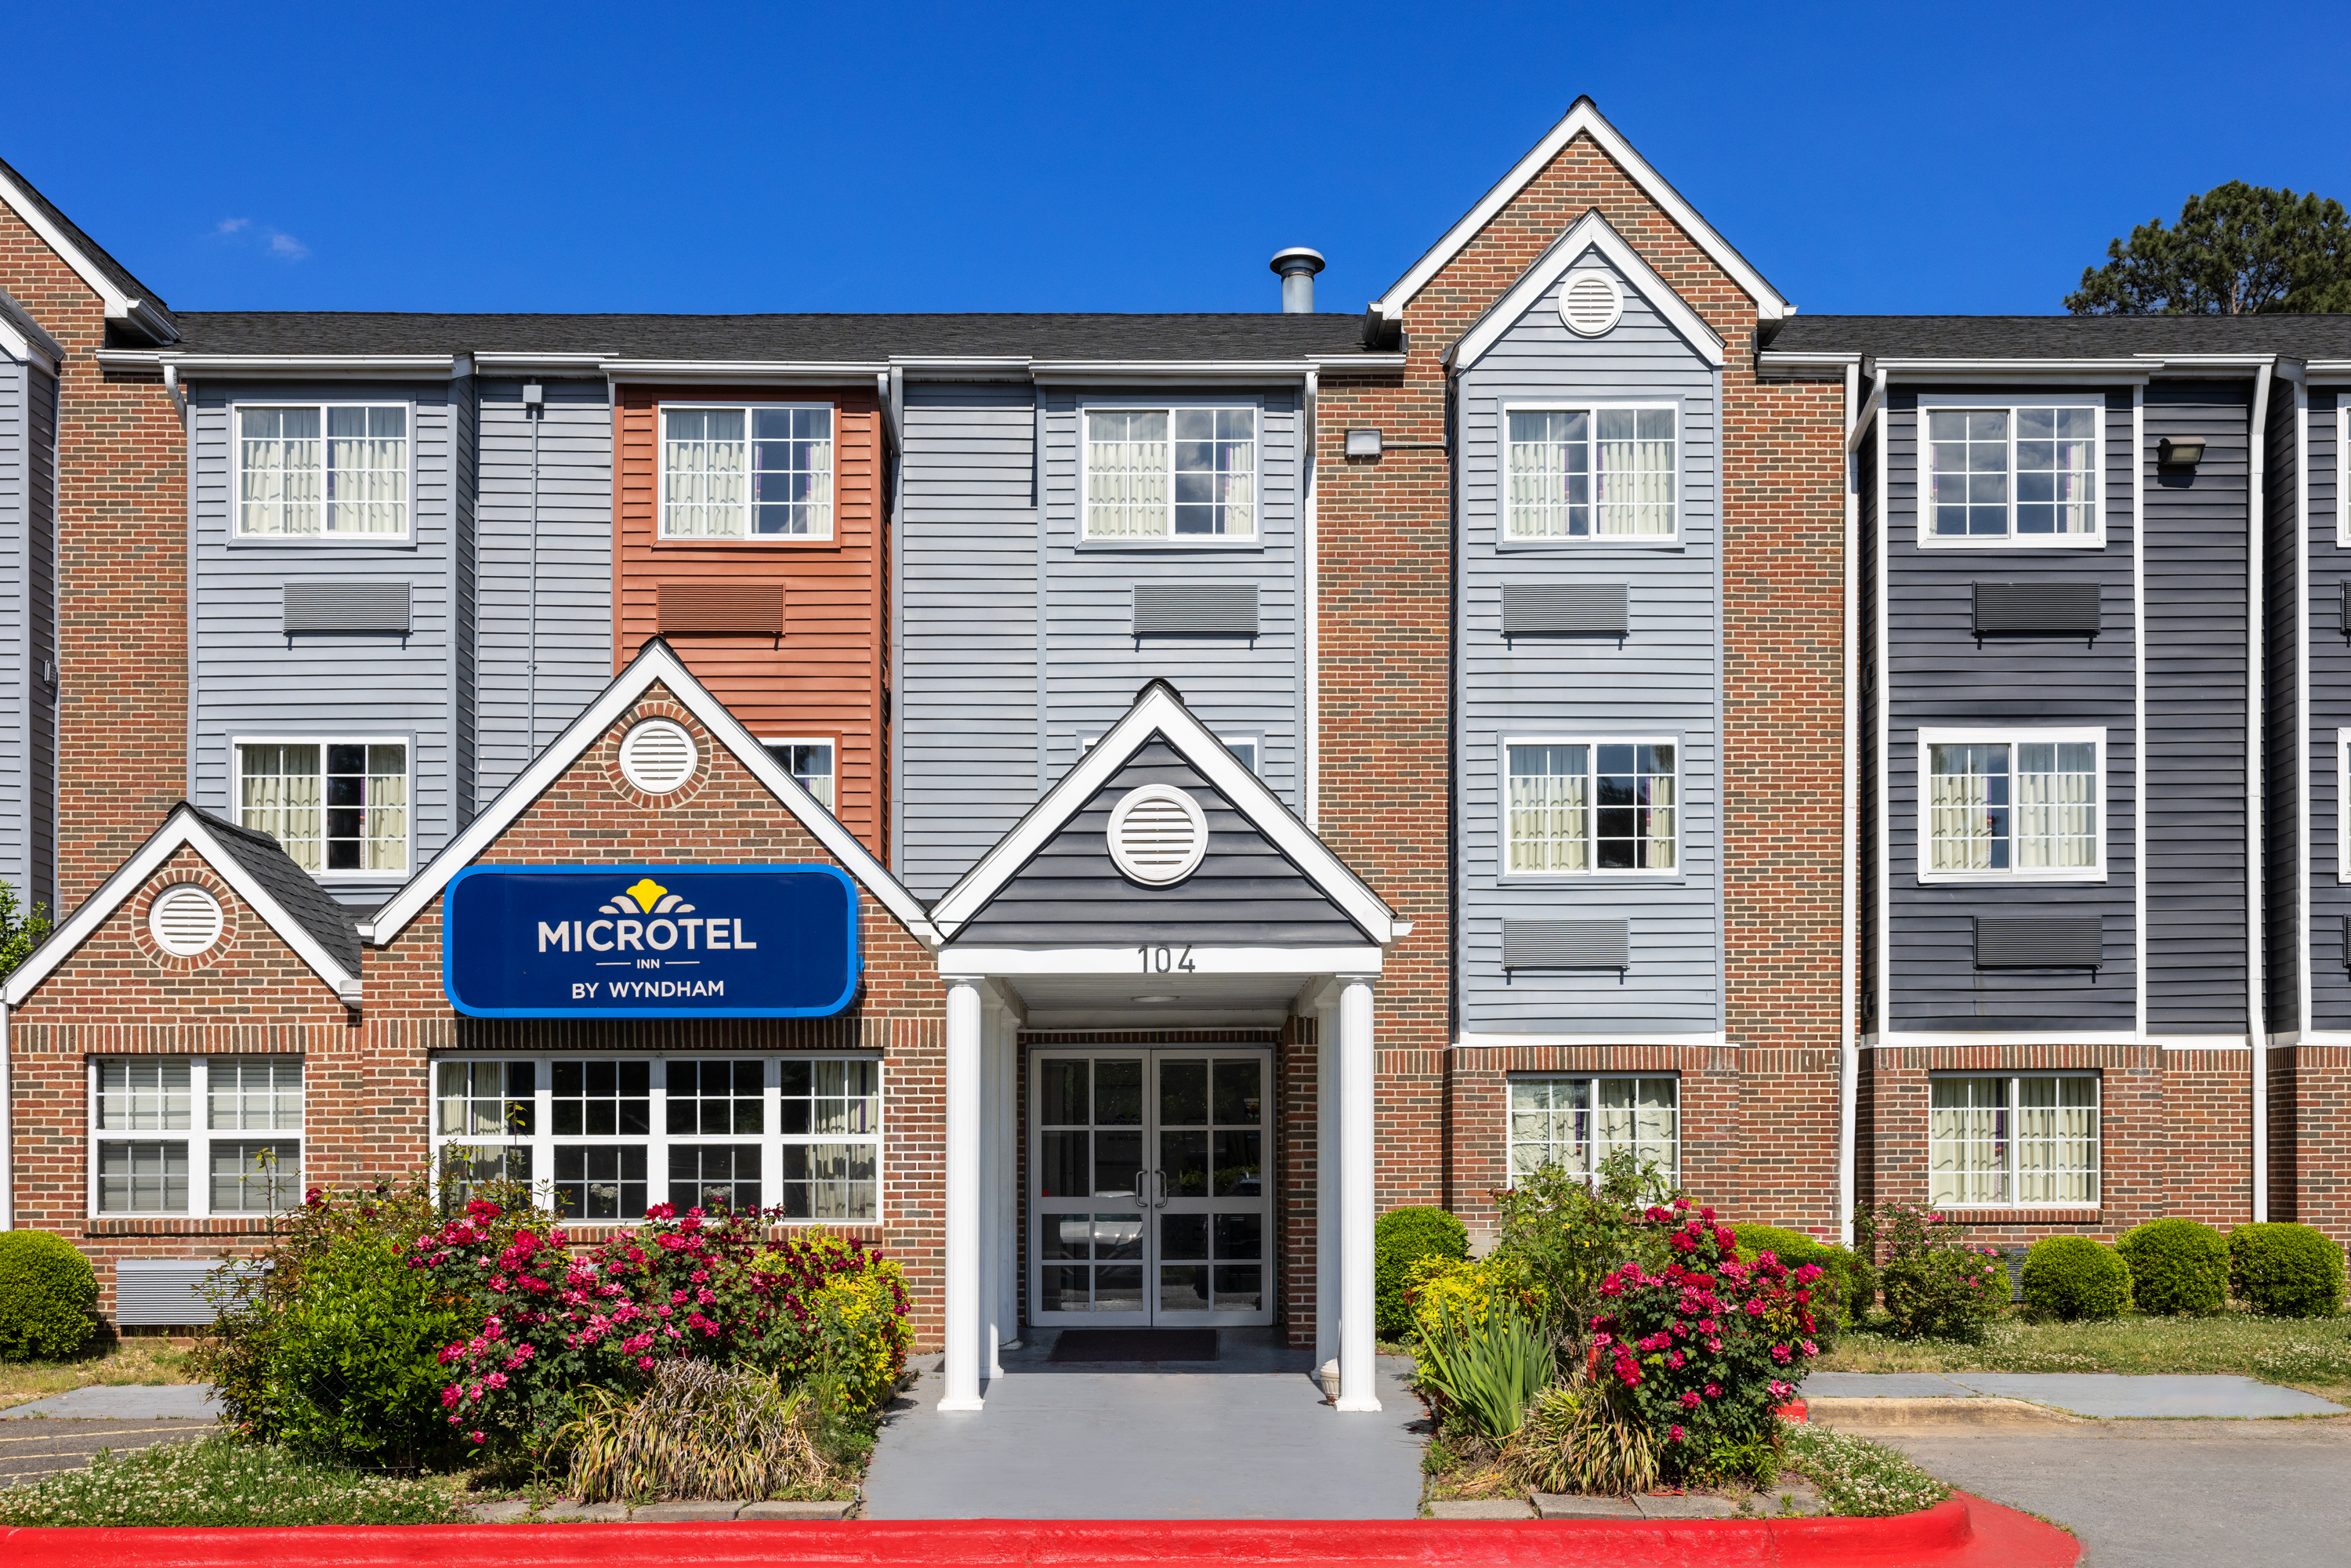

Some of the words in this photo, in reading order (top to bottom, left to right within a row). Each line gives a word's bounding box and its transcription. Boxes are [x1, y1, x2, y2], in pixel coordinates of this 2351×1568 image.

[538, 918, 757, 953] MICROTEL
[636, 958, 660, 969] INN
[1139, 945, 1195, 972] 104
[572, 982, 600, 999] BY
[609, 980, 724, 998] WYNDHAM
